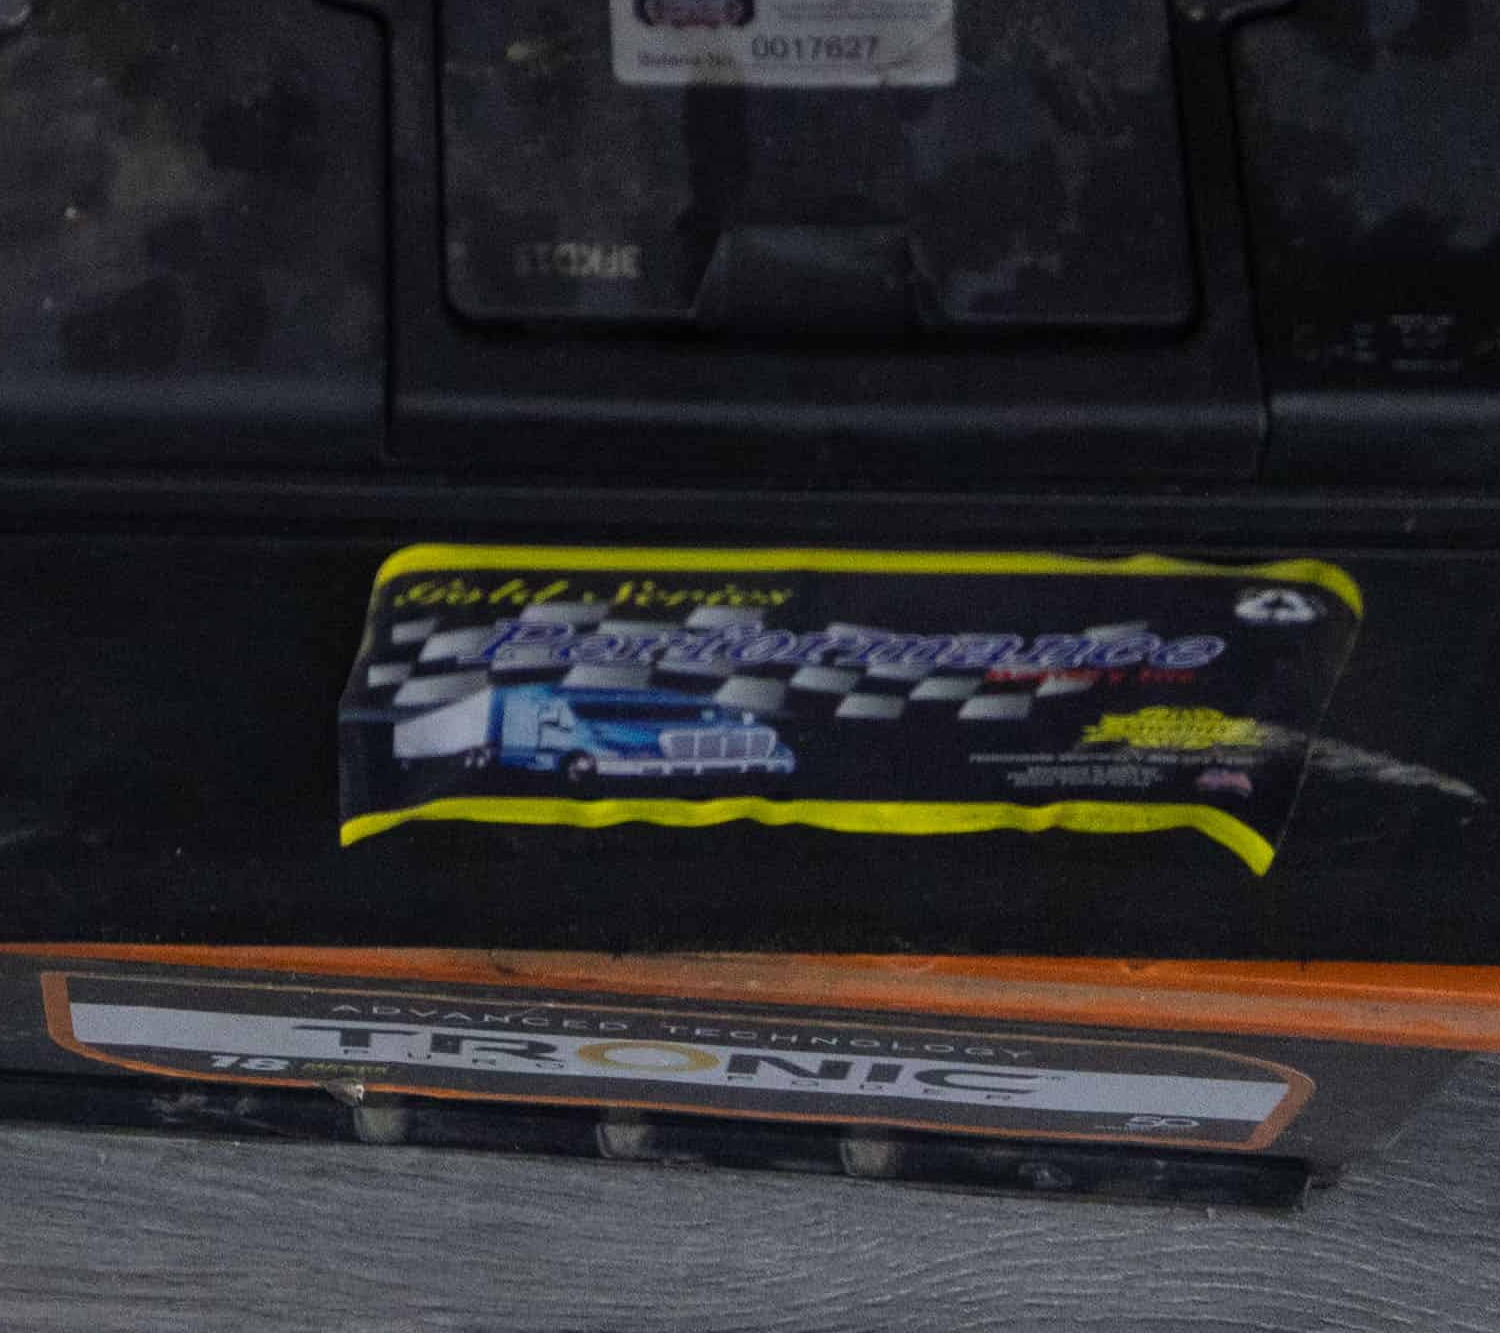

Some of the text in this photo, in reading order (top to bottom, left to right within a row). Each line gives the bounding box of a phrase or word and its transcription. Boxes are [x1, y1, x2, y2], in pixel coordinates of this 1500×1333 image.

[751, 35, 878, 61] 0017627
[291, 1024, 1041, 1095] TRONIC
[331, 1004, 1033, 1060] ADVANCED TECHNOLOGY
